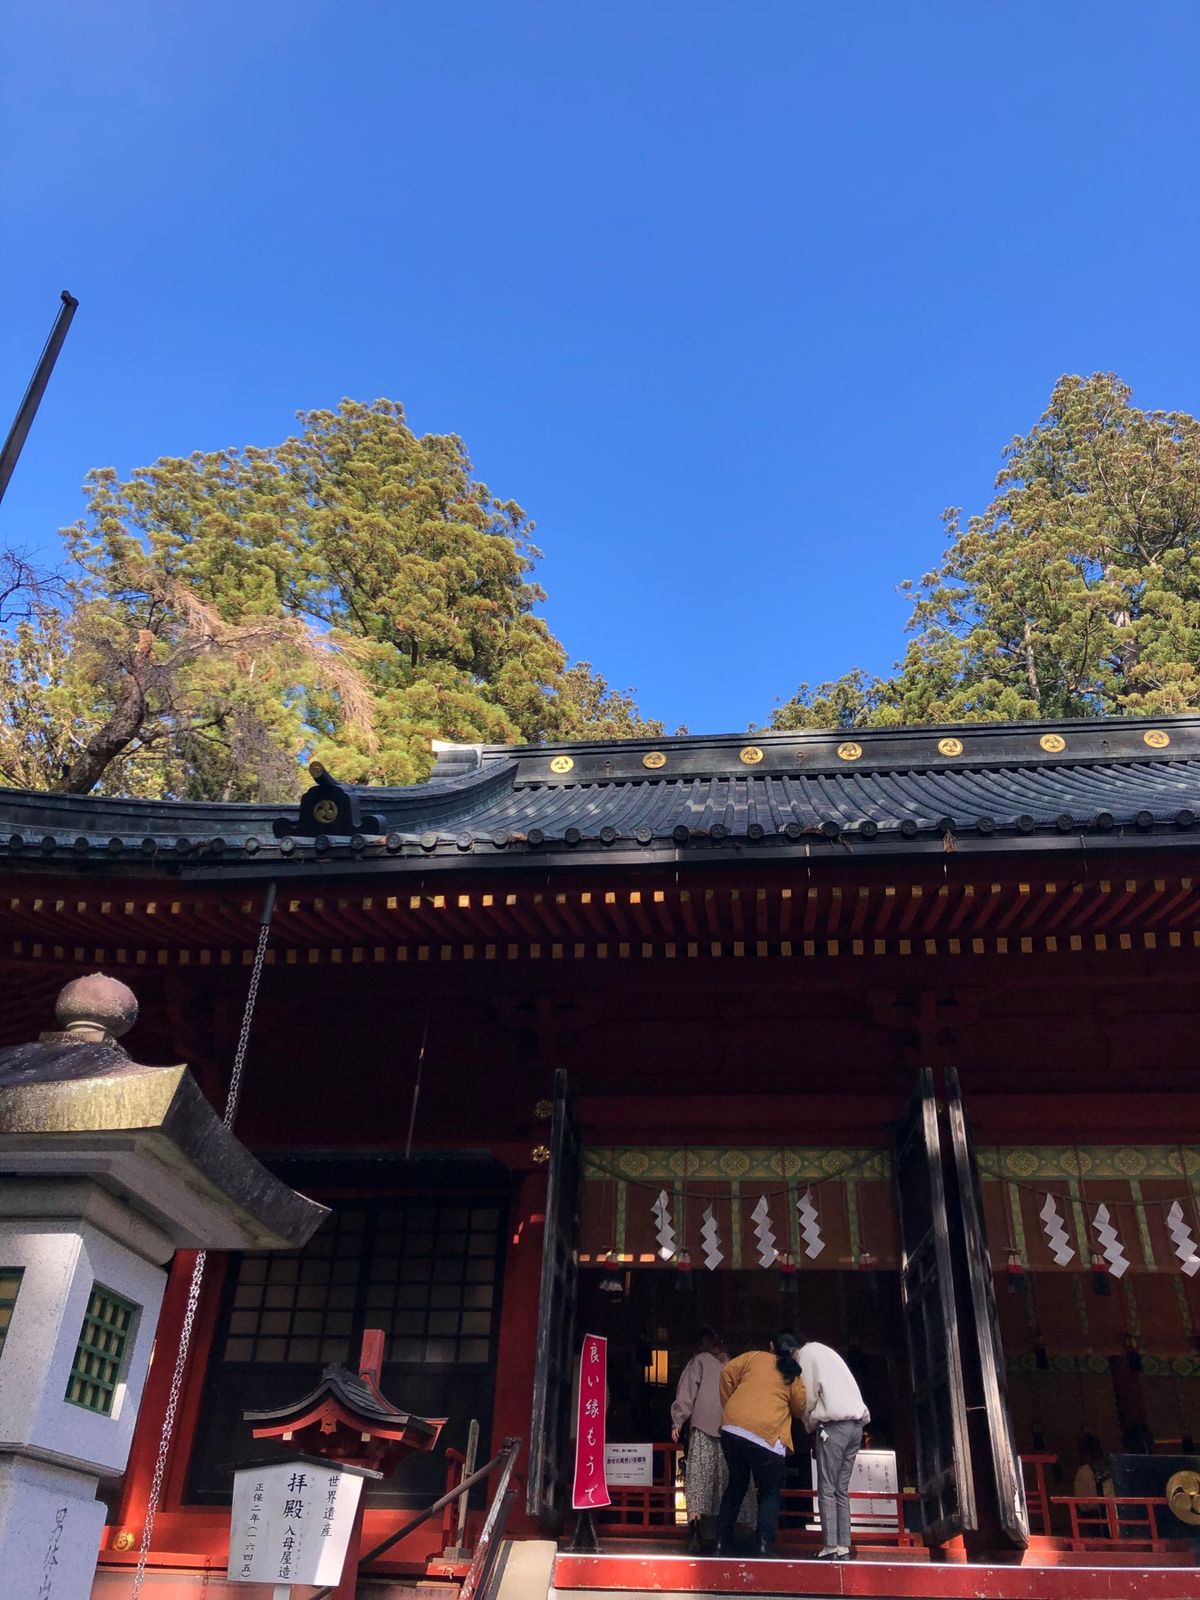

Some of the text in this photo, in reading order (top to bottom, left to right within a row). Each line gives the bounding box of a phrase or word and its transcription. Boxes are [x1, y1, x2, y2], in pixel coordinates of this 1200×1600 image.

[585, 1343, 600, 1504] 良い縁もうで
[283, 1472, 308, 1520] 拝殿
[320, 1475, 340, 1537] 世界遺産
